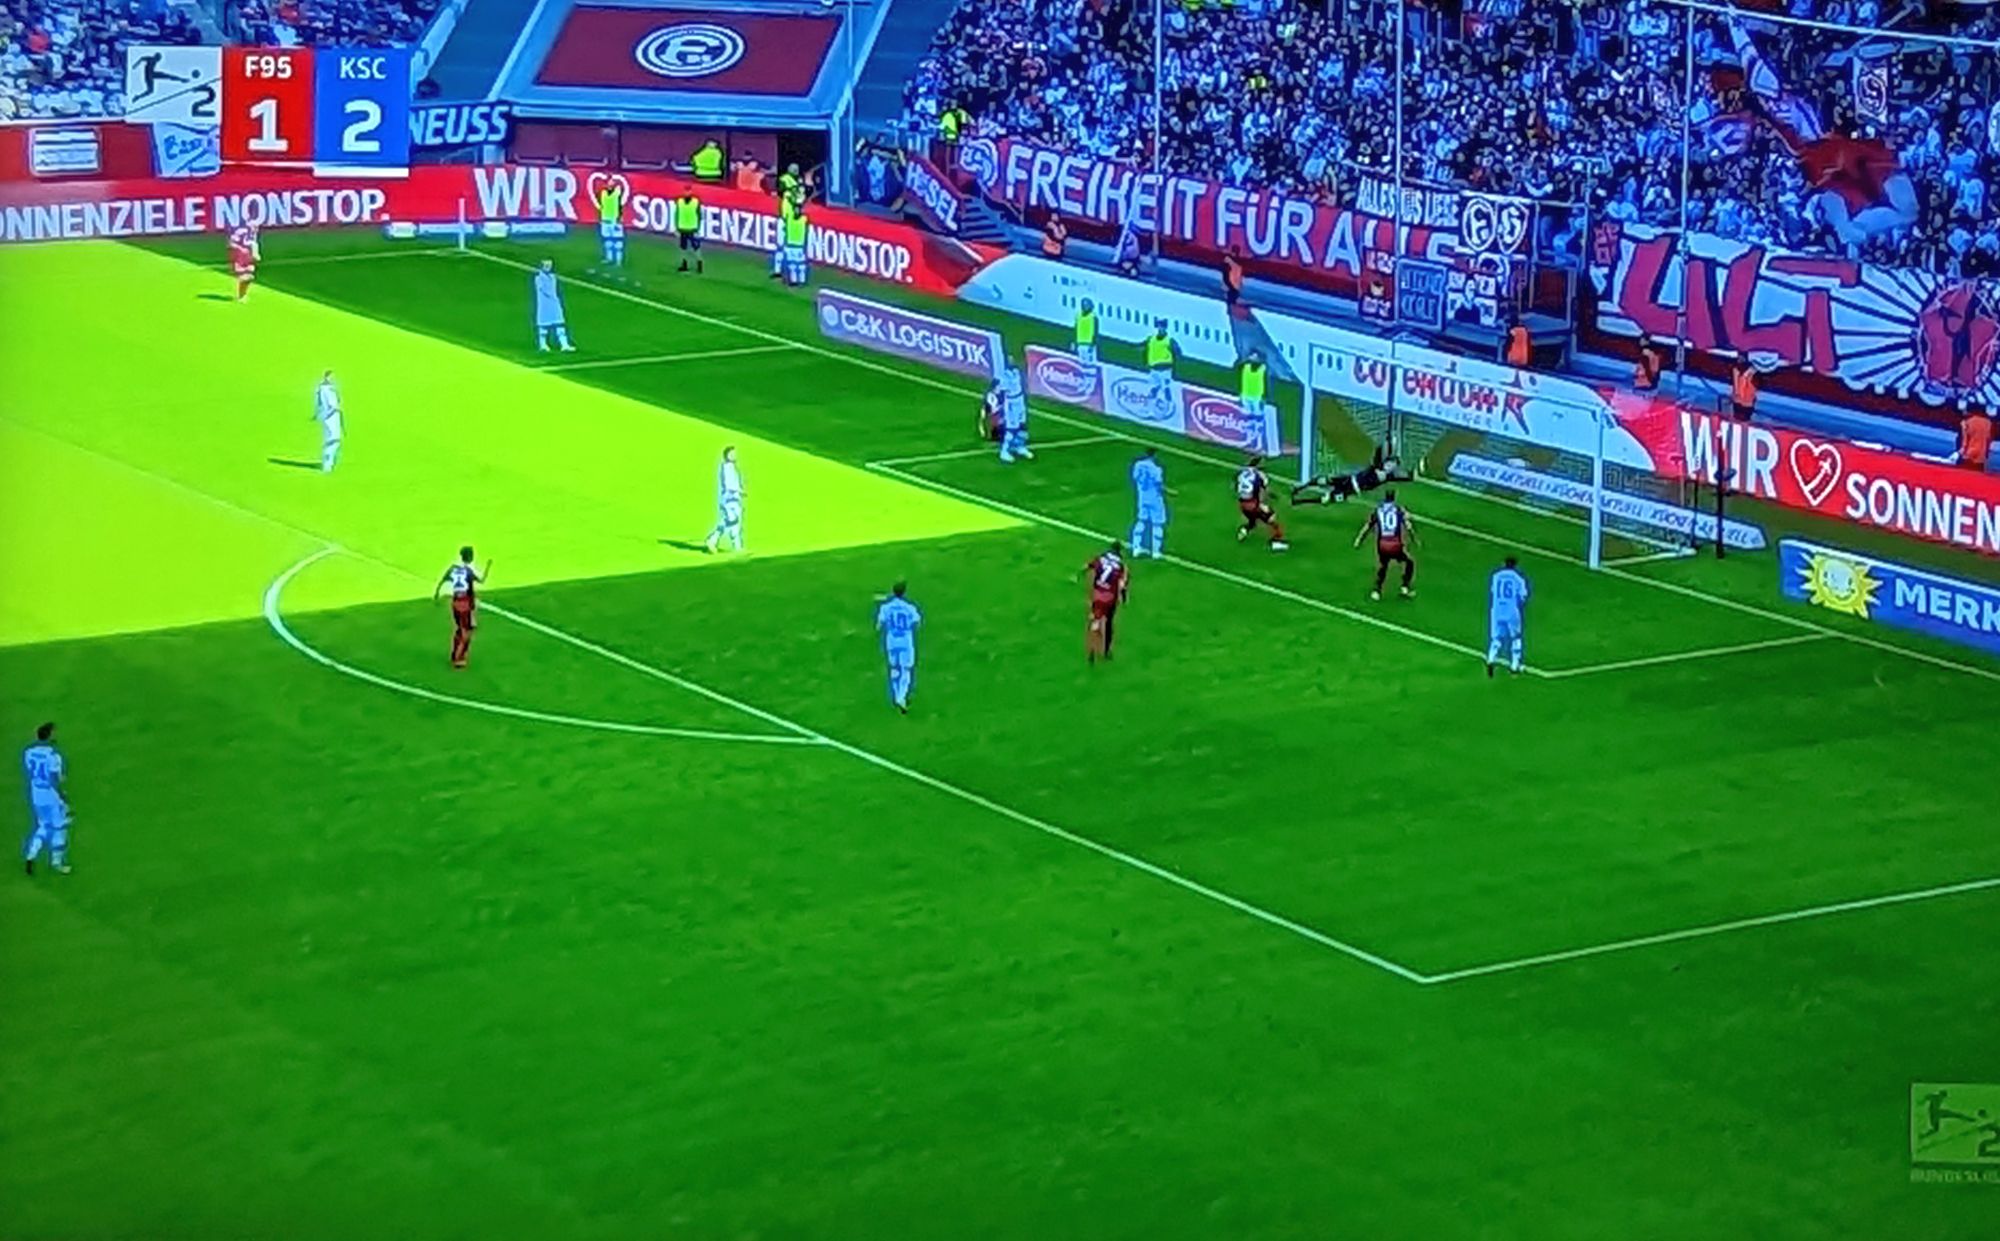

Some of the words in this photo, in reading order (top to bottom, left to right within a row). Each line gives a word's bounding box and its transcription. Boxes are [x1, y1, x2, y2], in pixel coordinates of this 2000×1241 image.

[410, 105, 509, 145] NEUSS
[214, 189, 391, 231] NONSTOP.
[475, 168, 577, 221] WIR
[632, 195, 790, 249] SOENZIE
[807, 224, 914, 283] NONSTOP.
[1005, 146, 1207, 241] FREIHEIT
[1216, 187, 1314, 266] FÜR
[841, 309, 887, 341] C&K
[888, 320, 990, 368] LOGISTIK
[1680, 411, 1778, 498] WIR
[1378, 509, 1398, 531] 10
